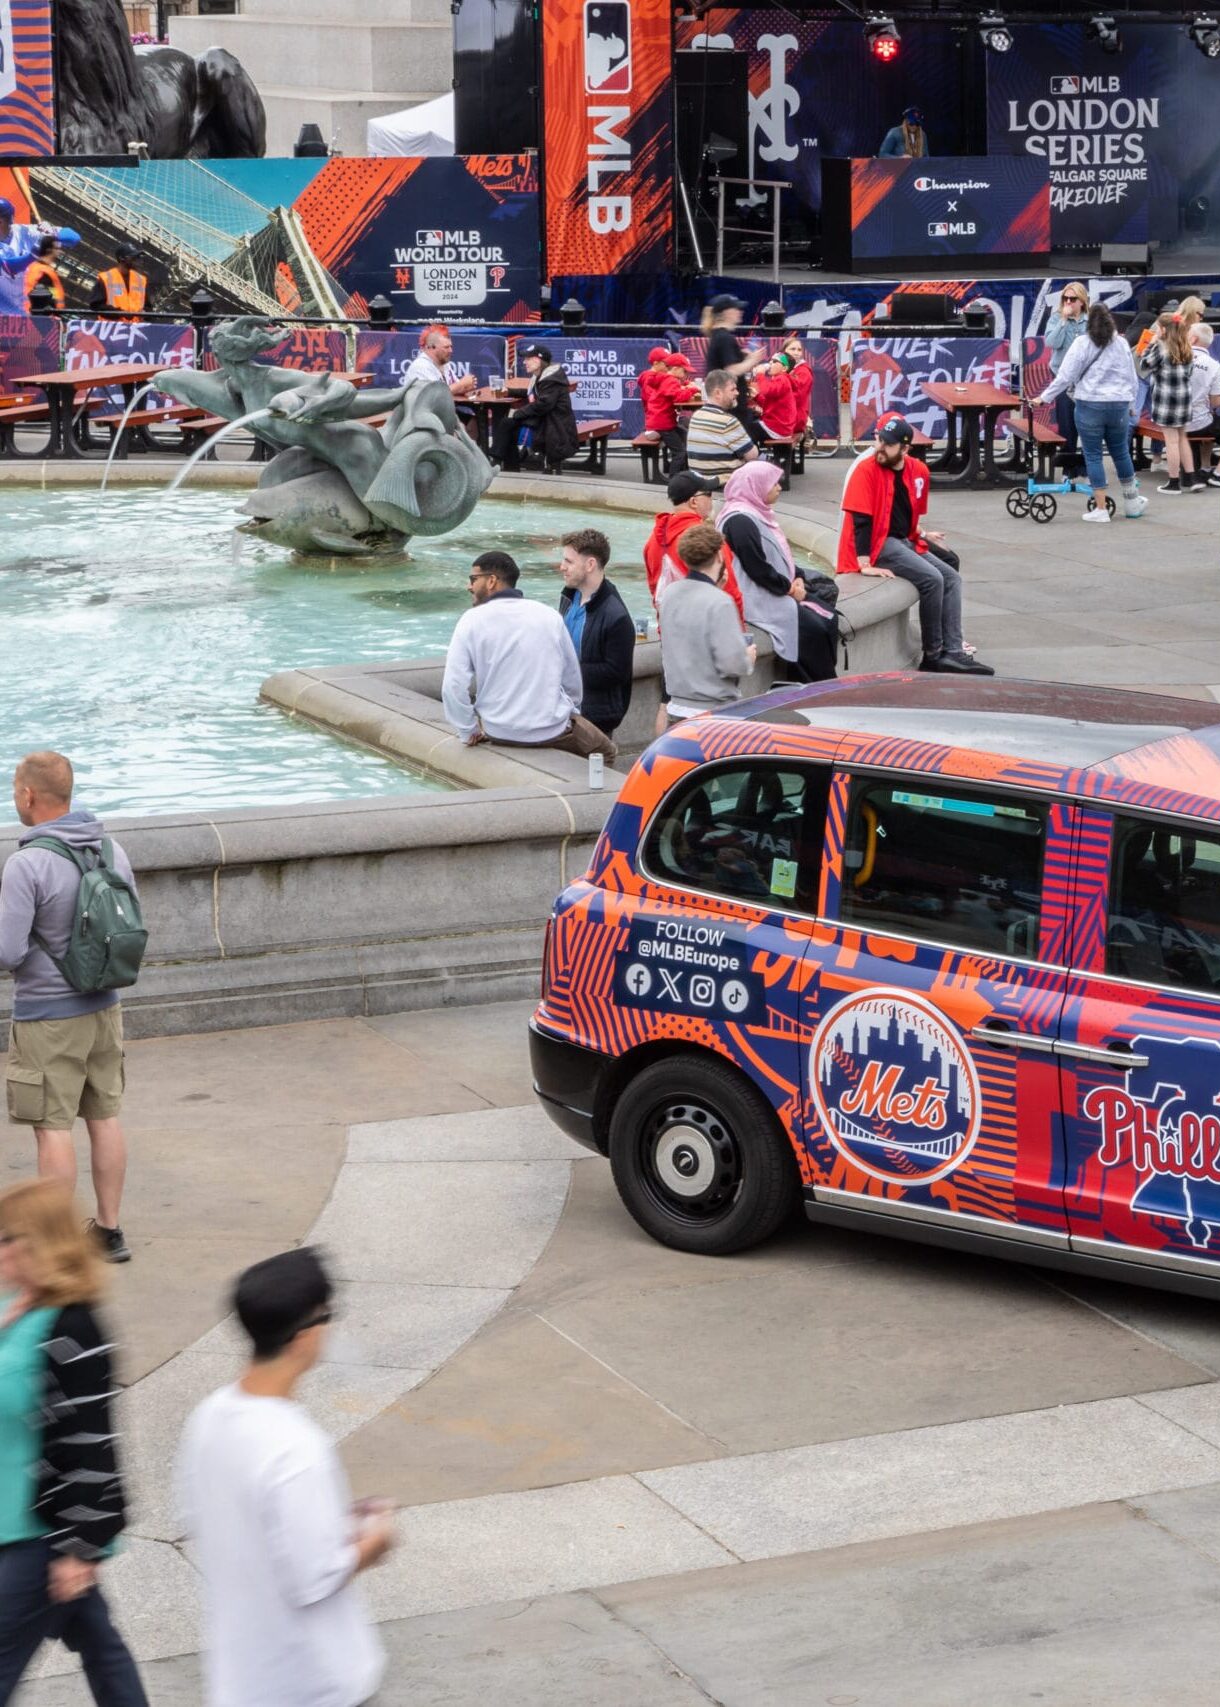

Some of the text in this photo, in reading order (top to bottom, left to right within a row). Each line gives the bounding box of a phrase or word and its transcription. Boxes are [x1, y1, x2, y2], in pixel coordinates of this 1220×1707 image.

[1081, 76, 1121, 93] MLB
[1008, 98, 1160, 132] LONDON
[1025, 133, 1145, 166] SERIES
[587, 105, 633, 234] MLB
[1049, 168, 1148, 182] FALGAR SQUARE
[914, 177, 990, 194] Champion
[949, 222, 976, 235] MLB
[444, 231, 481, 246] MLB
[394, 247, 503, 263] WORLD TOUR
[423, 268, 477, 280] LONDON
[428, 280, 472, 292] SERIES
[588, 350, 618, 363] MLB
[561, 363, 636, 377] ORLD TOUR
[575, 380, 615, 391] ONDON
[575, 390, 611, 400] SERIES
[656, 921, 726, 947] FOLLOW
[638, 940, 740, 972] @MLBEurope
[839, 1060, 950, 1131] Mets
